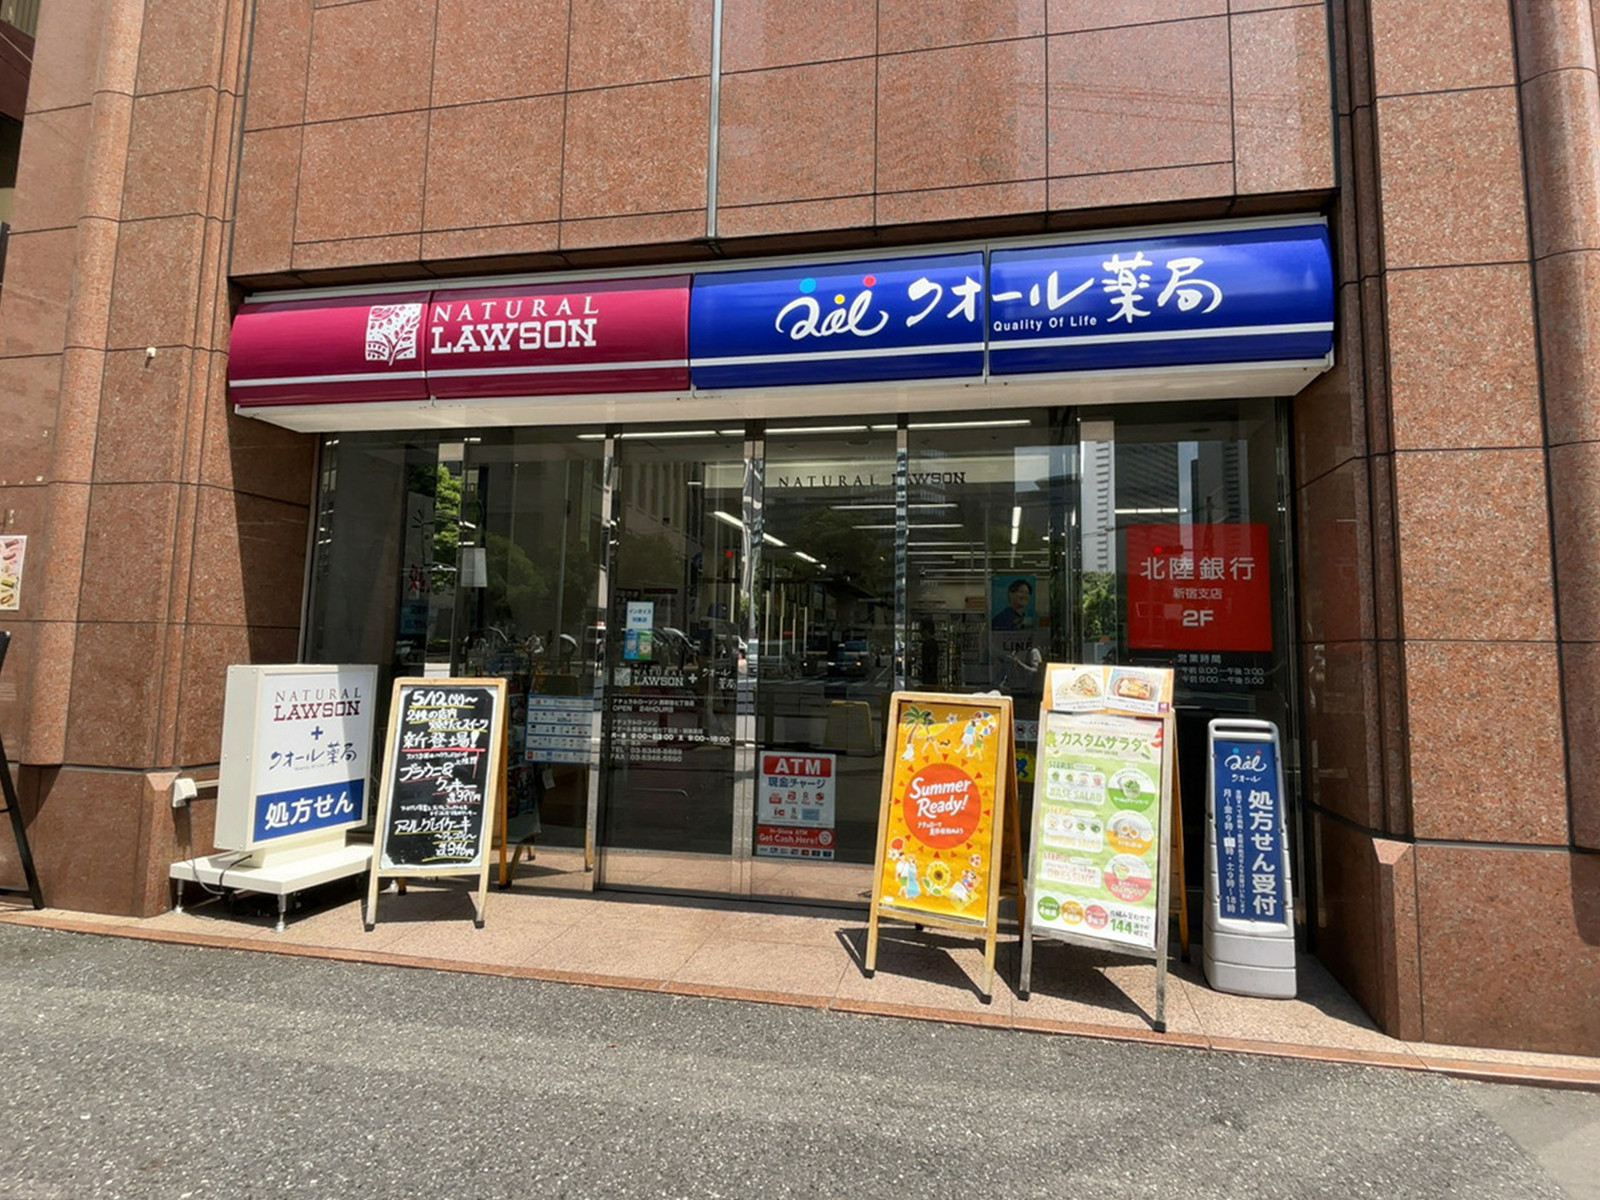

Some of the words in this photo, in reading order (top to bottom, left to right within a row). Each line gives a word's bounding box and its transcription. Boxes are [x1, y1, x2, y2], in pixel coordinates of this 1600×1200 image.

[905, 251, 1223, 328] クオール薬局
[432, 296, 599, 323] NATURAL
[993, 318, 1043, 333] Quality
[1048, 317, 1065, 328] Of
[1069, 315, 1098, 327] Life
[430, 317, 598, 354] LAWSON
[778, 474, 880, 487] NATURAL
[1140, 556, 1255, 581] 北陸銀行
[1173, 588, 1223, 600] 新宿支店
[1182, 609, 1214, 627] 2F
[633, 676, 684, 686] LAWSON
[275, 687, 362, 703] NATURAL
[273, 701, 361, 722] LAWSON
[1060, 731, 1147, 752] カスタムサラダ
[268, 742, 358, 770] クオール薬局
[775, 757, 821, 775] ATM
[435, 777, 478, 793] クッキー
[768, 776, 826, 789] 現金チャージ
[1231, 774, 1261, 783] クオール
[909, 776, 972, 800] Summer
[264, 791, 354, 831] 処方せん
[917, 794, 969, 820] Ready!
[760, 833, 774, 842] Get
[774, 833, 795, 845] Cash
[1248, 789, 1277, 917] 処方せん受付
[1110, 918, 1132, 934] 144
